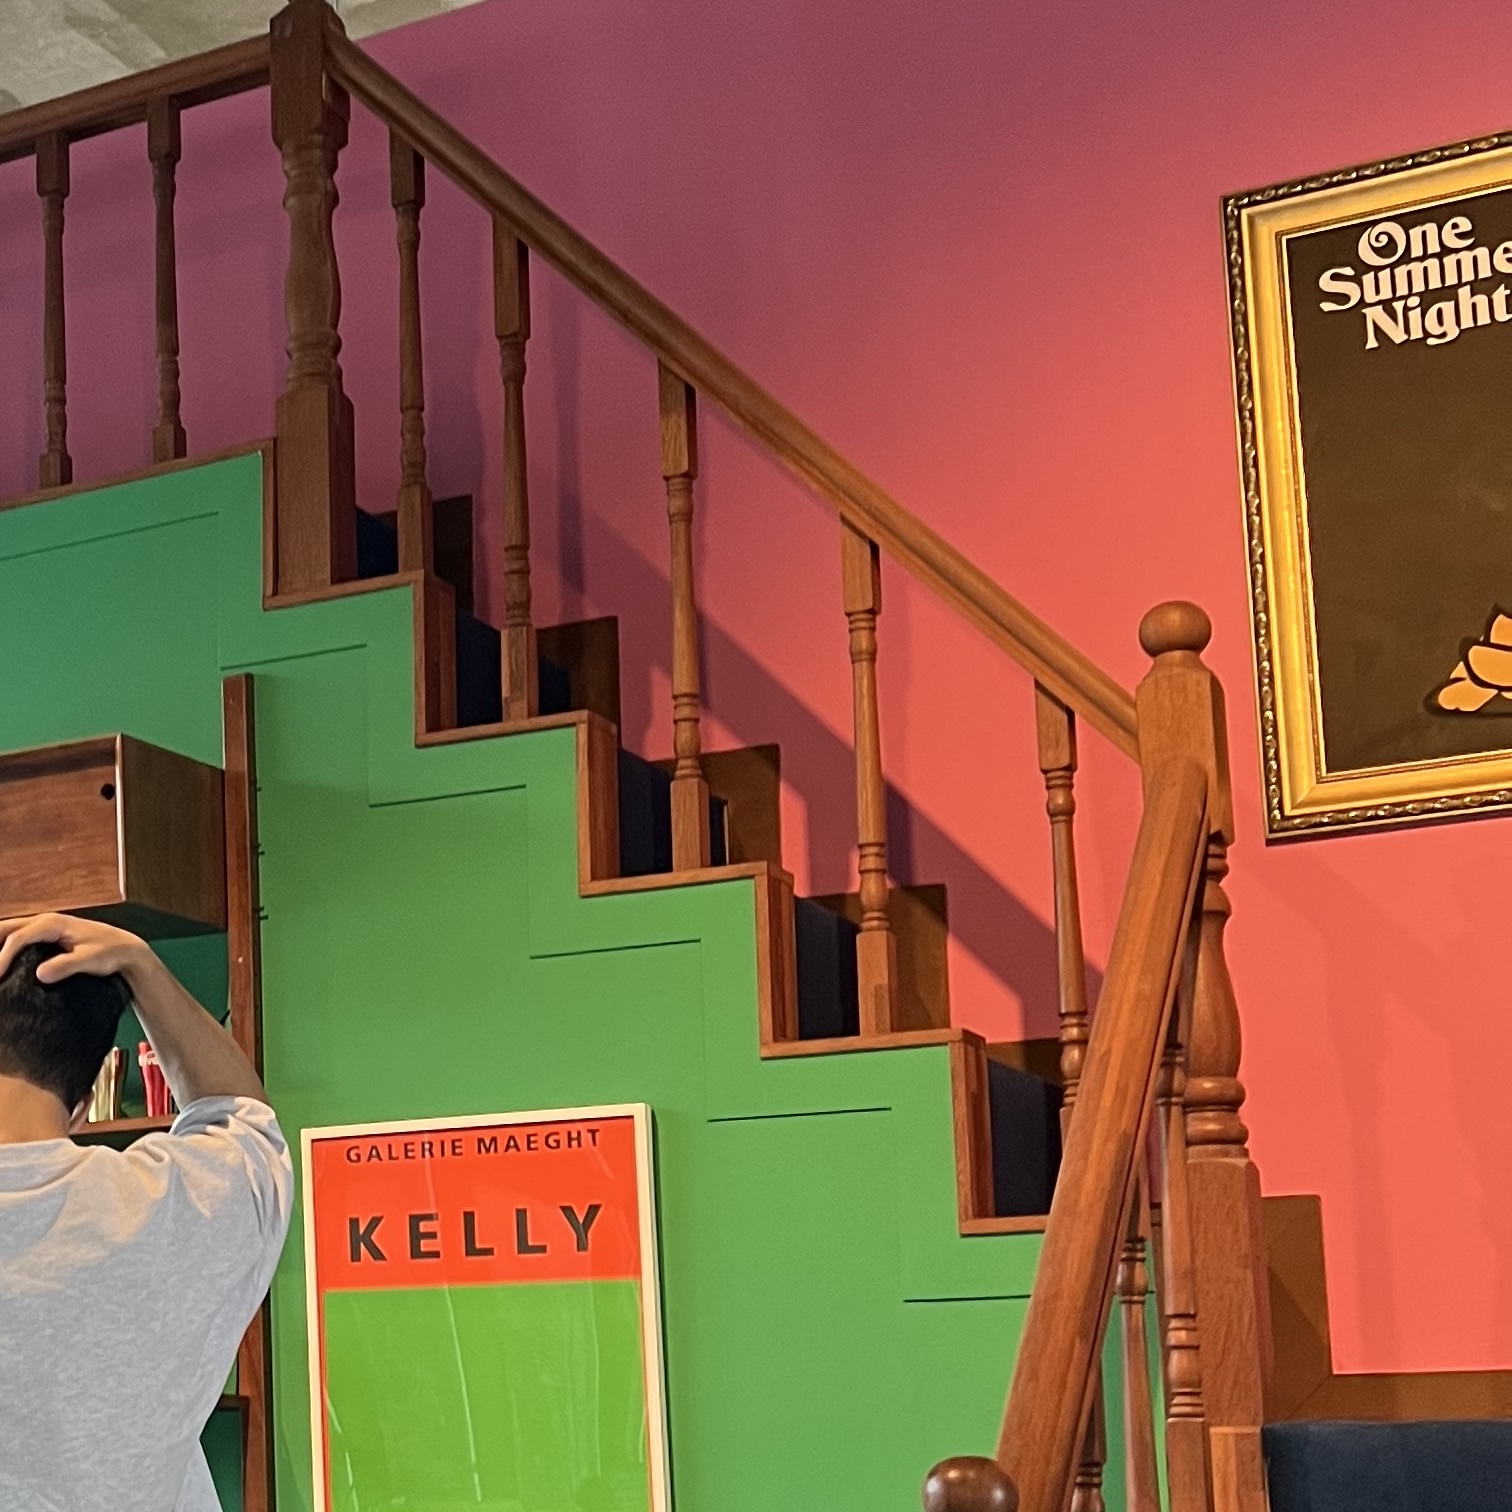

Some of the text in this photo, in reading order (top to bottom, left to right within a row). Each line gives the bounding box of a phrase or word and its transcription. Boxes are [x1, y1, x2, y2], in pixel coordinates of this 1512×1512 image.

[1357, 215, 1476, 266] One
[1361, 283, 1512, 350] Night
[346, 1128, 601, 1164] GALERIE MAEGHT
[348, 1203, 603, 1264] KELLY
